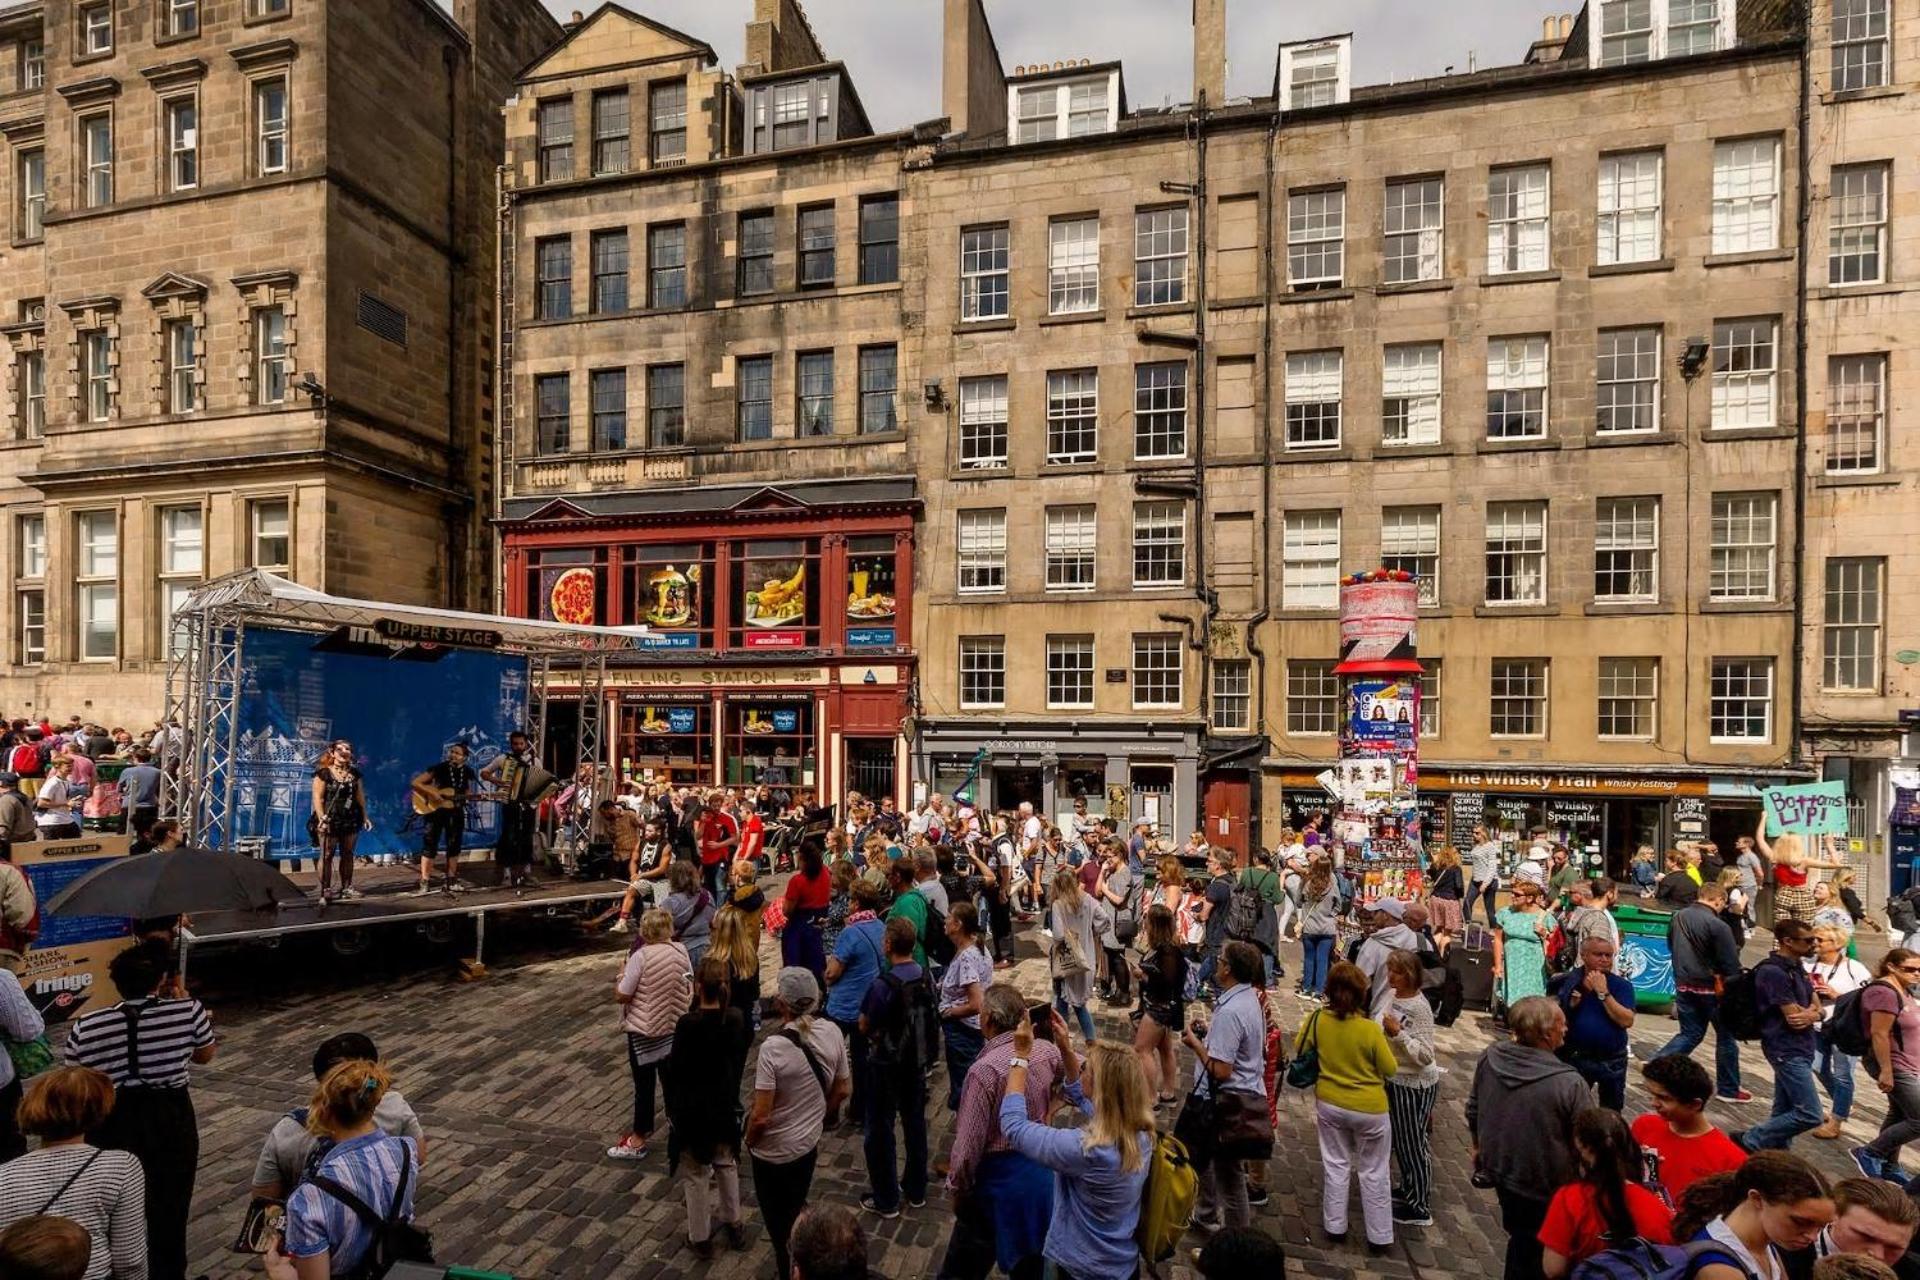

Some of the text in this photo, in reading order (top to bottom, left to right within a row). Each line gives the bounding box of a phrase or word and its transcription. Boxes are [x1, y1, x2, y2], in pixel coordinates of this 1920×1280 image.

[386, 621, 493, 646] UPPER STAGE
[559, 672, 595, 685] THE
[611, 671, 682, 685] FILLING
[701, 670, 777, 685] STATION
[1448, 771, 1598, 790] The Whisky Trail
[1604, 778, 1678, 790] Whisky Tastings
[1293, 794, 1323, 804] Wines
[1455, 798, 1483, 807] SCOTCH
[1496, 799, 1531, 812] Single
[1769, 791, 1844, 814] Bottoms
[1554, 800, 1595, 813] Whisky
[1678, 803, 1706, 812] LOST
[1500, 809, 1527, 820] Malt
[1547, 810, 1601, 824] Specialist
[1779, 807, 1828, 828] UP!
[23, 949, 61, 963] SHARE
[25, 962, 31, 970] A
[33, 953, 68, 968] SHOW
[36, 972, 94, 995] fringe
